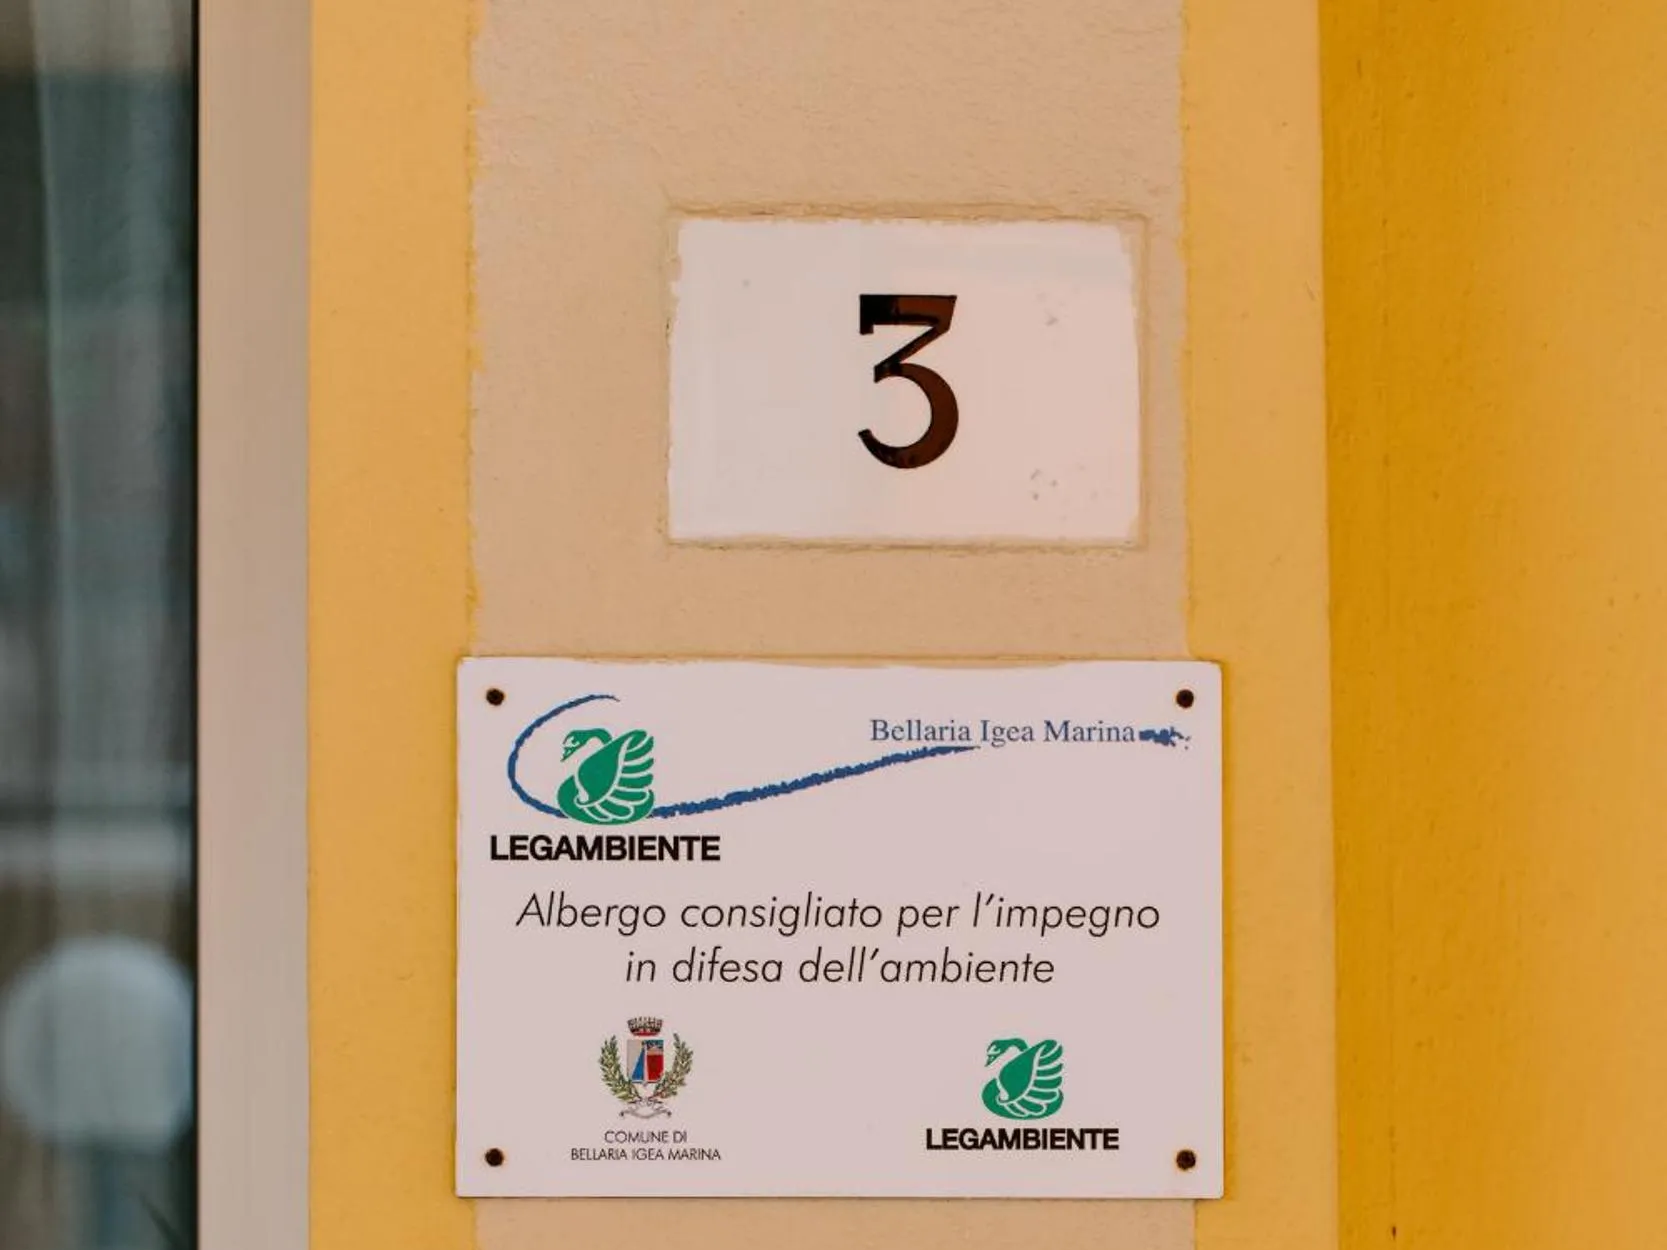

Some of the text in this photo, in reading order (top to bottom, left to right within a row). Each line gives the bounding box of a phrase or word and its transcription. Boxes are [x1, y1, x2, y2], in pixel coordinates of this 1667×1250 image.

[857, 293, 959, 470] 3
[870, 718, 1137, 748] Bellaria Igea Marina
[489, 833, 722, 862] LEGAMBIENTE
[515, 890, 1160, 938] Albergo consigliato per l'impegno
[625, 945, 1055, 984] in difesa dell'ambiente
[604, 1130, 688, 1144] COMUNE DI
[925, 1127, 1120, 1151] LEGAMBIENTE
[570, 1147, 722, 1161] BELLARIA IGEA MARINA
